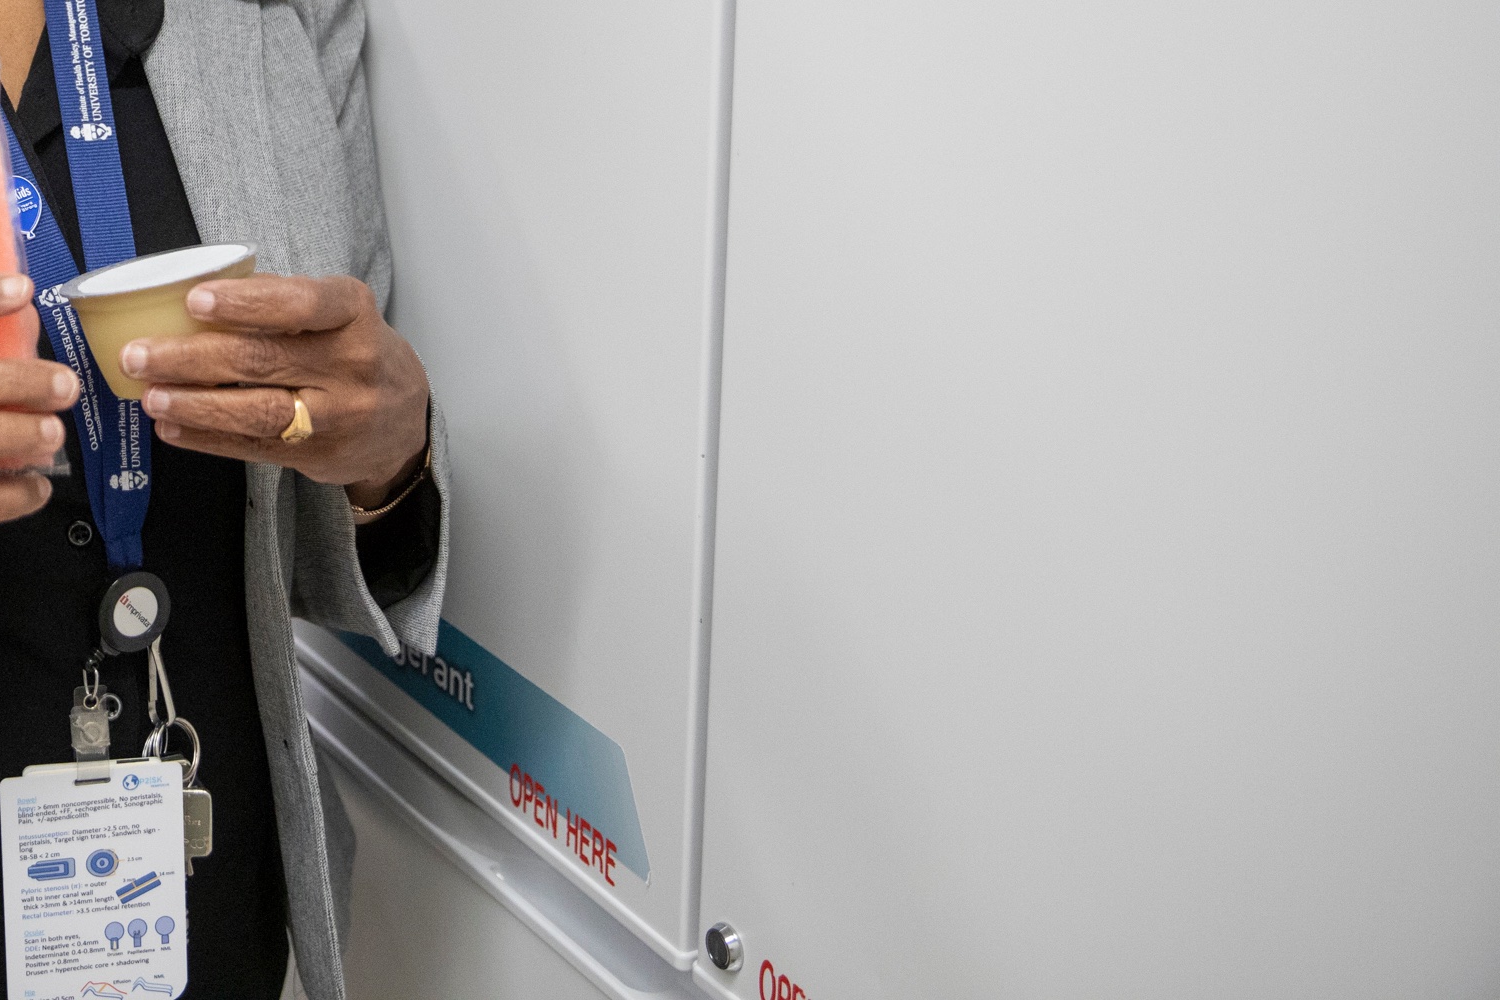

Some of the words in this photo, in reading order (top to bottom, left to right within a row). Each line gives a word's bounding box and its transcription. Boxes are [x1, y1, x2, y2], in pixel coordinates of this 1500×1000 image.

[65, 1, 78, 42] Management
[82, 45, 92, 58] OF
[74, 64, 84, 86] Health
[76, 86, 84, 94] of
[84, 60, 102, 121] UNIVERSITY
[80, 96, 89, 121] Institute
[64, 304, 78, 334] Institute
[52, 308, 82, 376] UNIVERSITY
[75, 334, 82, 344] of
[78, 344, 90, 369] Health
[80, 380, 86, 393] OF
[80, 394, 98, 451] TORONTO
[119, 426, 126, 437] of
[130, 400, 140, 468] UNIVERSITY
[120, 438, 128, 468] Institute
[124, 798, 163, 808] Sonographic
[510, 764, 558, 839] OPEN
[566, 808, 617, 887] HERE
[19, 831, 69, 840] Intussusception:
[21, 886, 42, 895] Pyloric
[94, 895, 114, 904] length
[25, 951, 70, 960] Indeterminate
[72, 947, 106, 955] 0.4-0.8mm
[55, 964, 93, 974] hyperechoic
[116, 958, 149, 967] shadowing
